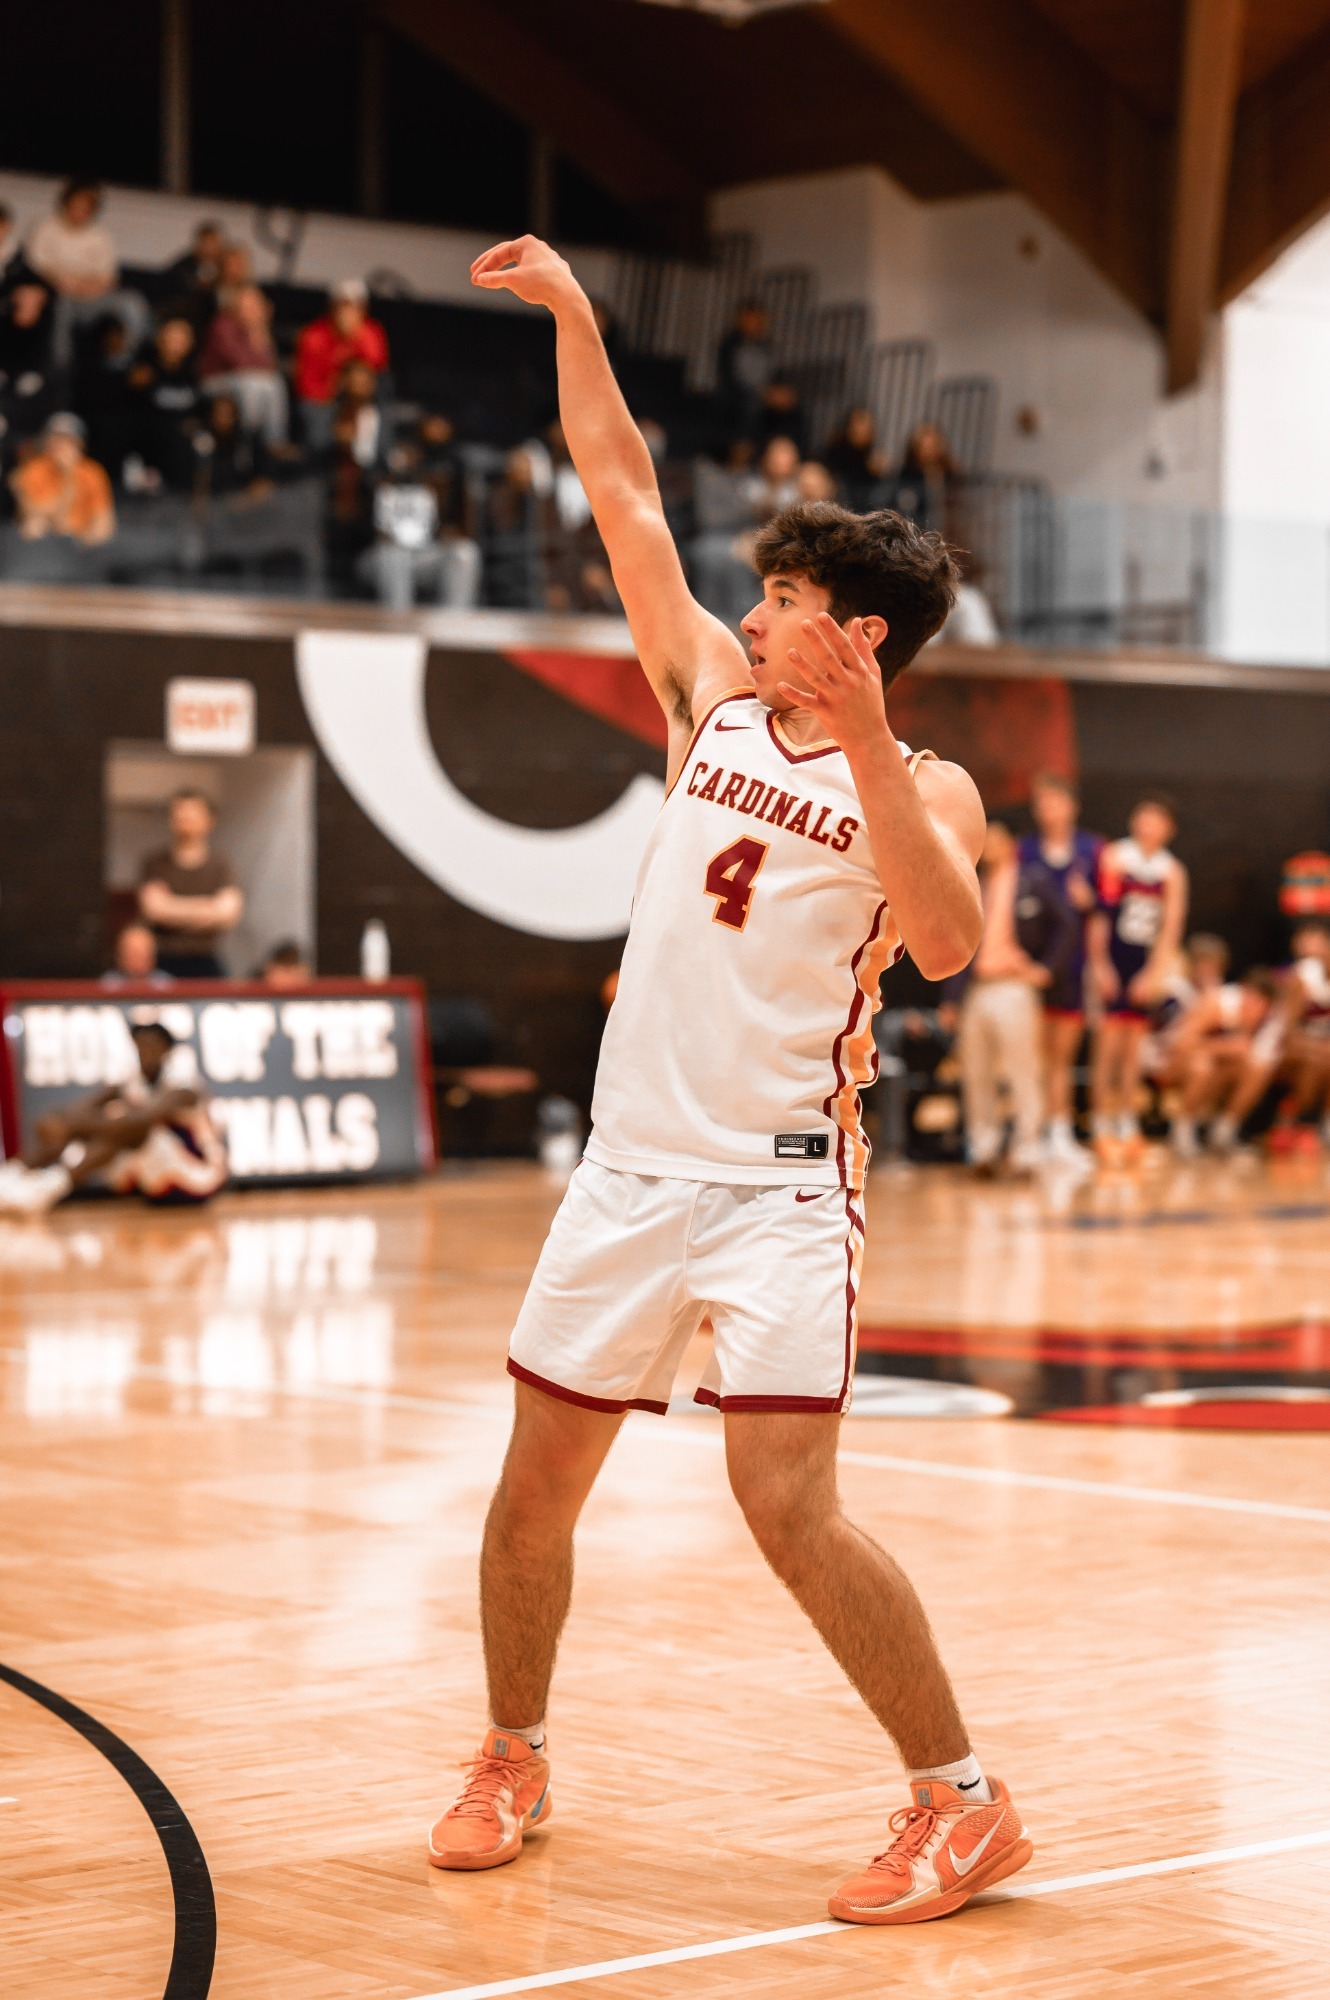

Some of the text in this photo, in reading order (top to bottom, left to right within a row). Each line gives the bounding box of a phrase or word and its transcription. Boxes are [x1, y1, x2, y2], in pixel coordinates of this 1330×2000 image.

[686, 761, 860, 852] CARDINALS
[703, 834, 770, 933] 4
[199, 1002, 275, 1081] OF
[280, 1001, 397, 1079] THE
[814, 1141, 821, 1152] L
